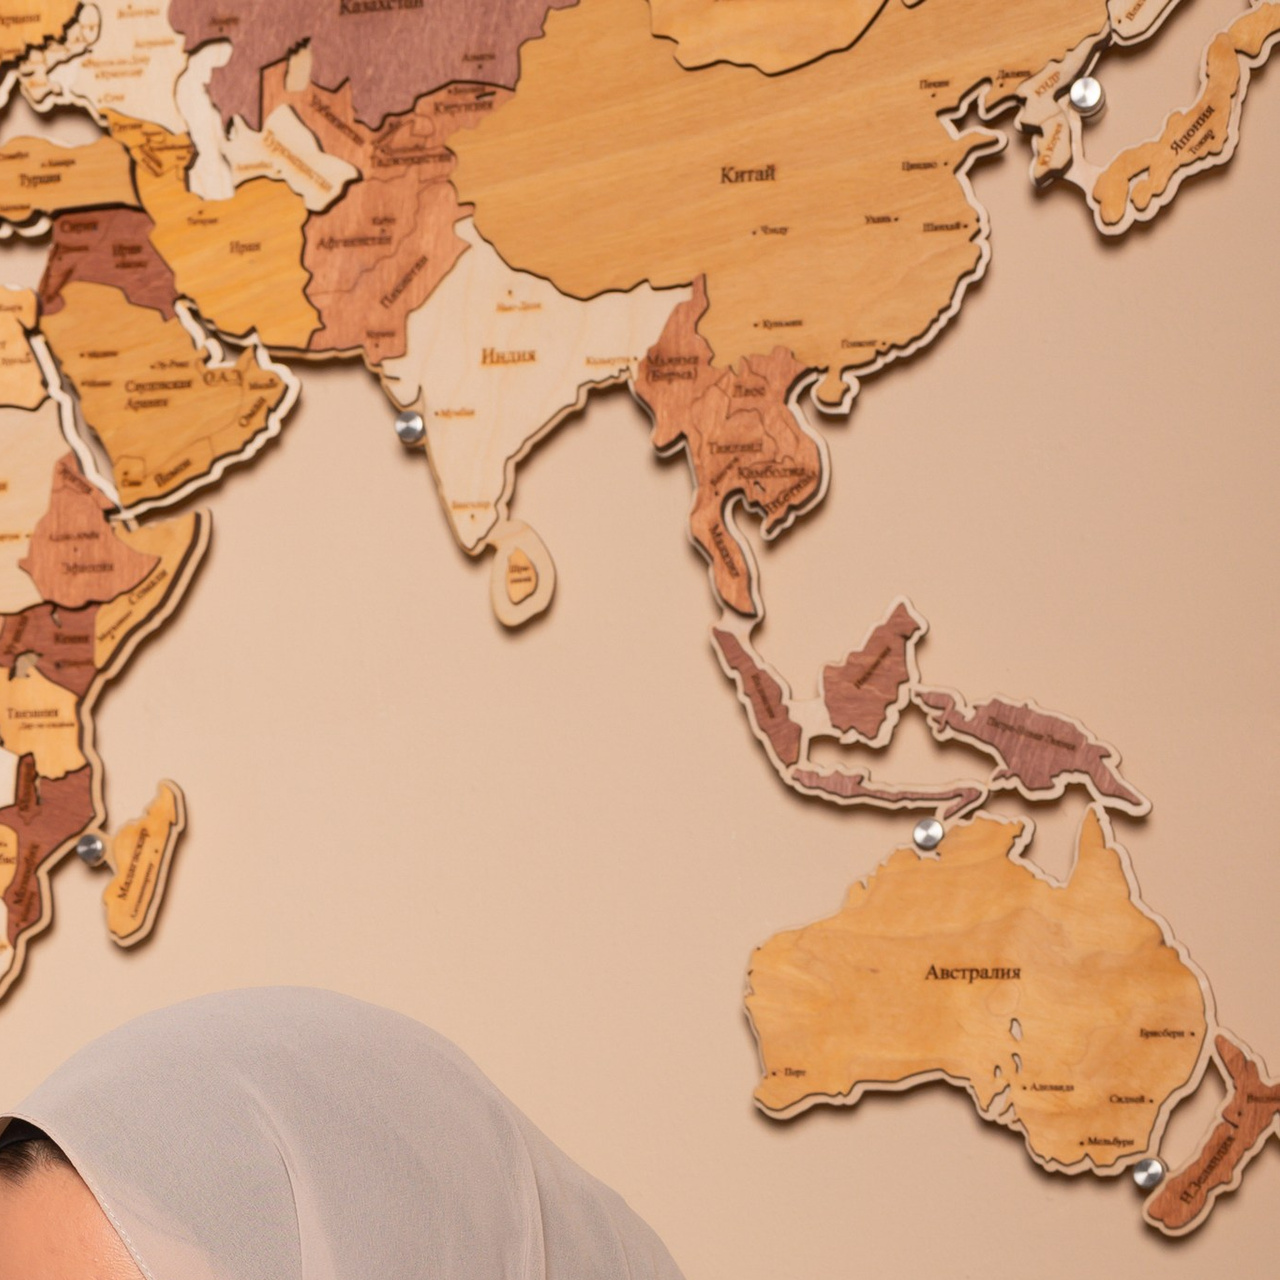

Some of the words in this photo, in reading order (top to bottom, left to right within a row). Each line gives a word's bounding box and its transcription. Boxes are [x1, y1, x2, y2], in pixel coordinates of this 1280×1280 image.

[1170, 105, 1216, 155] Япония
[720, 165, 777, 184] Китай
[481, 347, 537, 366] Индия
[924, 963, 1023, 985] Австралия
